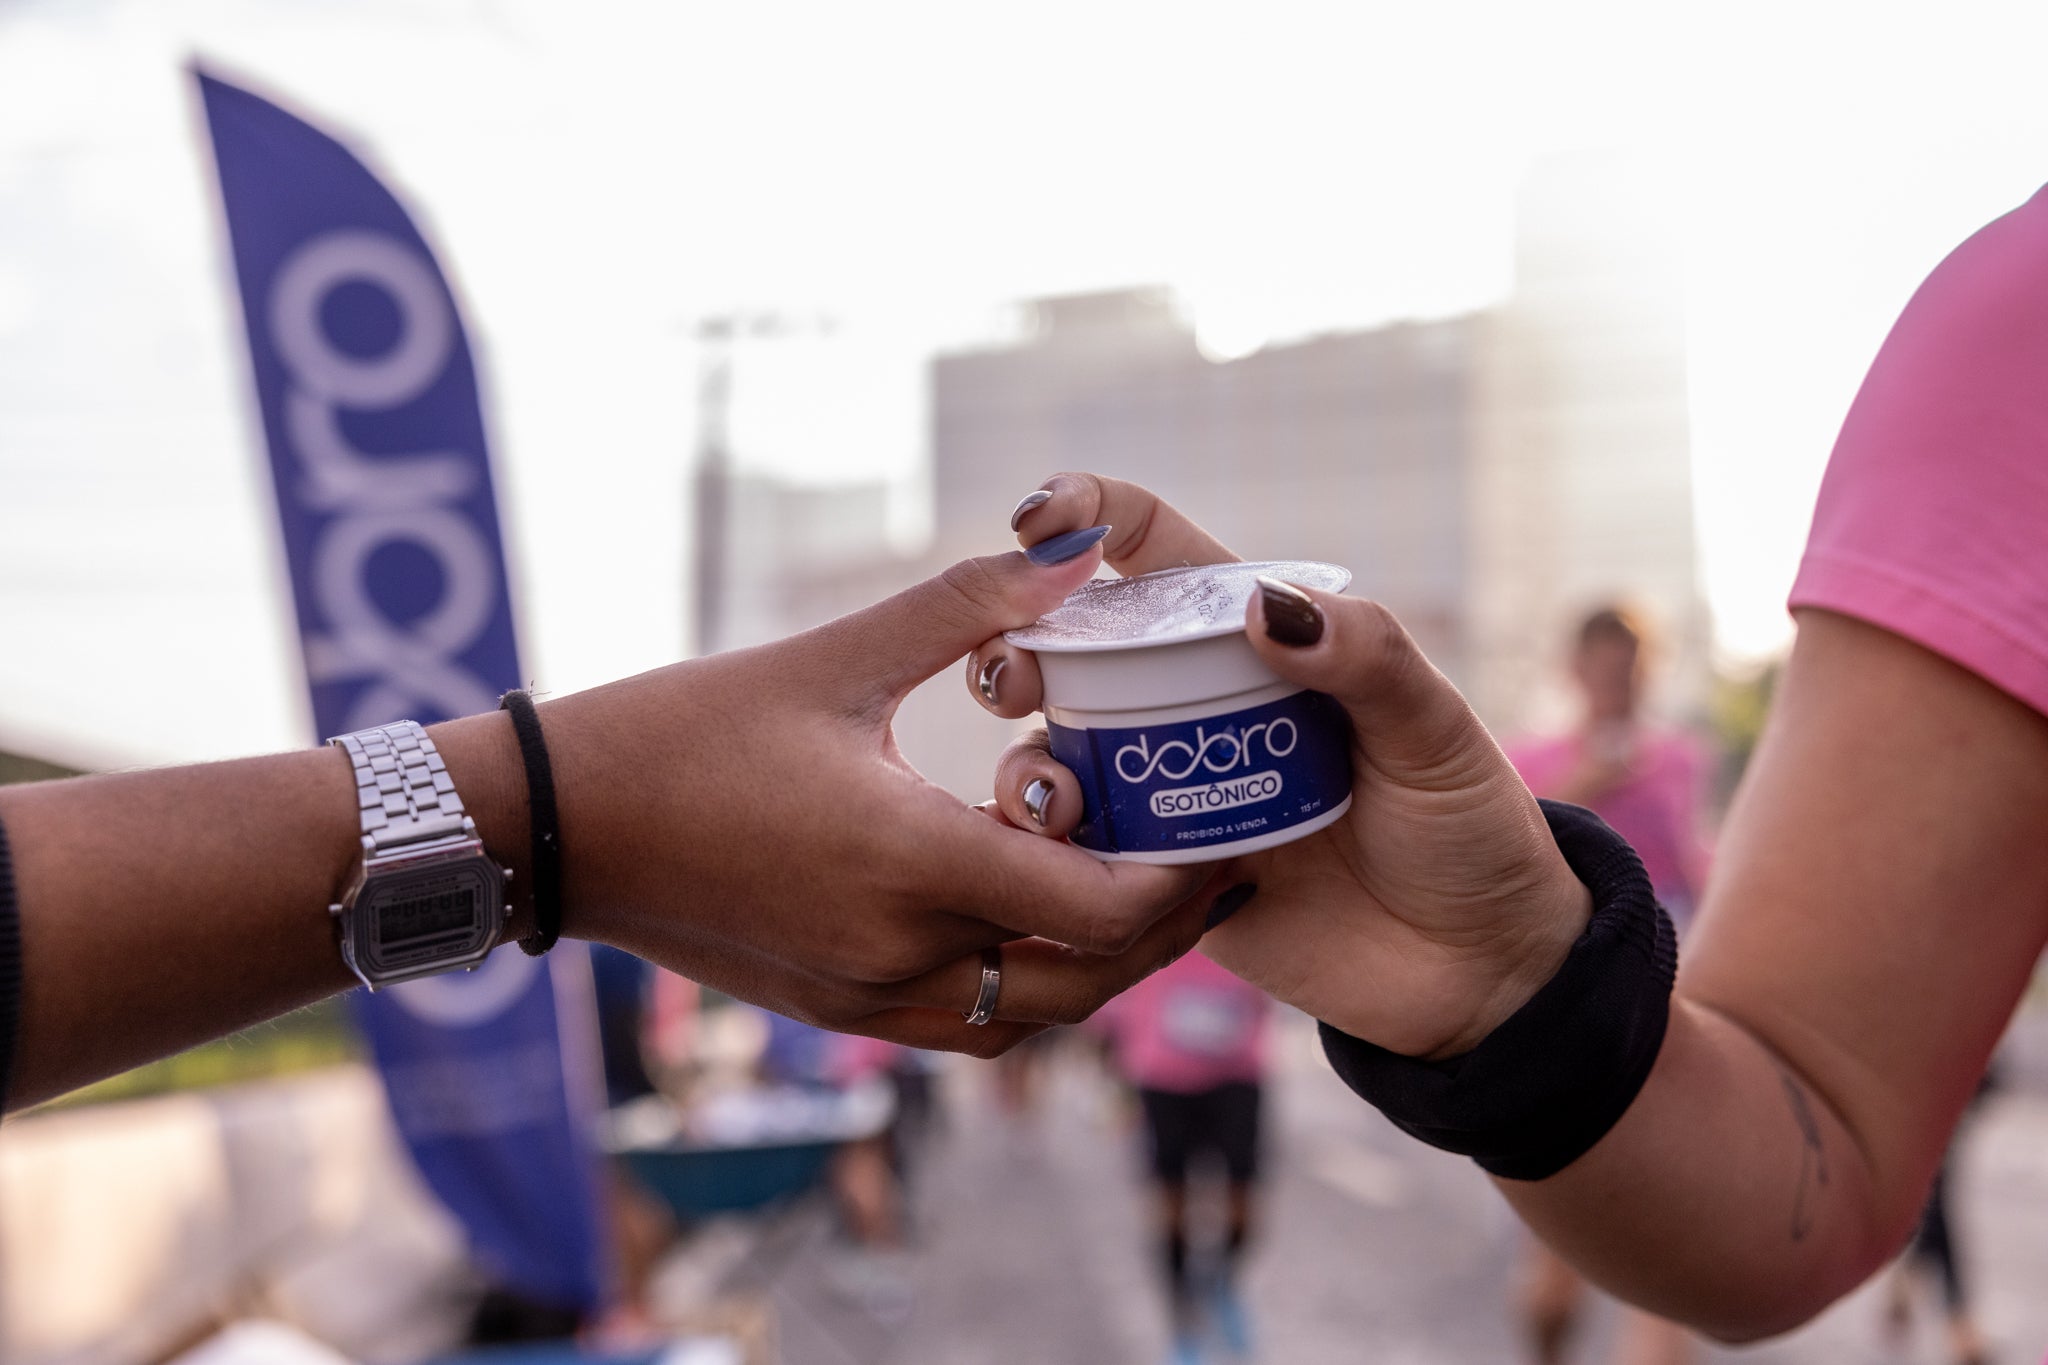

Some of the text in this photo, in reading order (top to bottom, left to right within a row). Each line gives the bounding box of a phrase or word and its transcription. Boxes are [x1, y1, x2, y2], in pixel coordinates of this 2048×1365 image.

[1114, 716, 1298, 784] dobro
[1154, 775, 1278, 815] ISOTÔNICO
[1300, 802, 1312, 813] 115
[1176, 816, 1268, 841] PROIBIDO A VENDA
